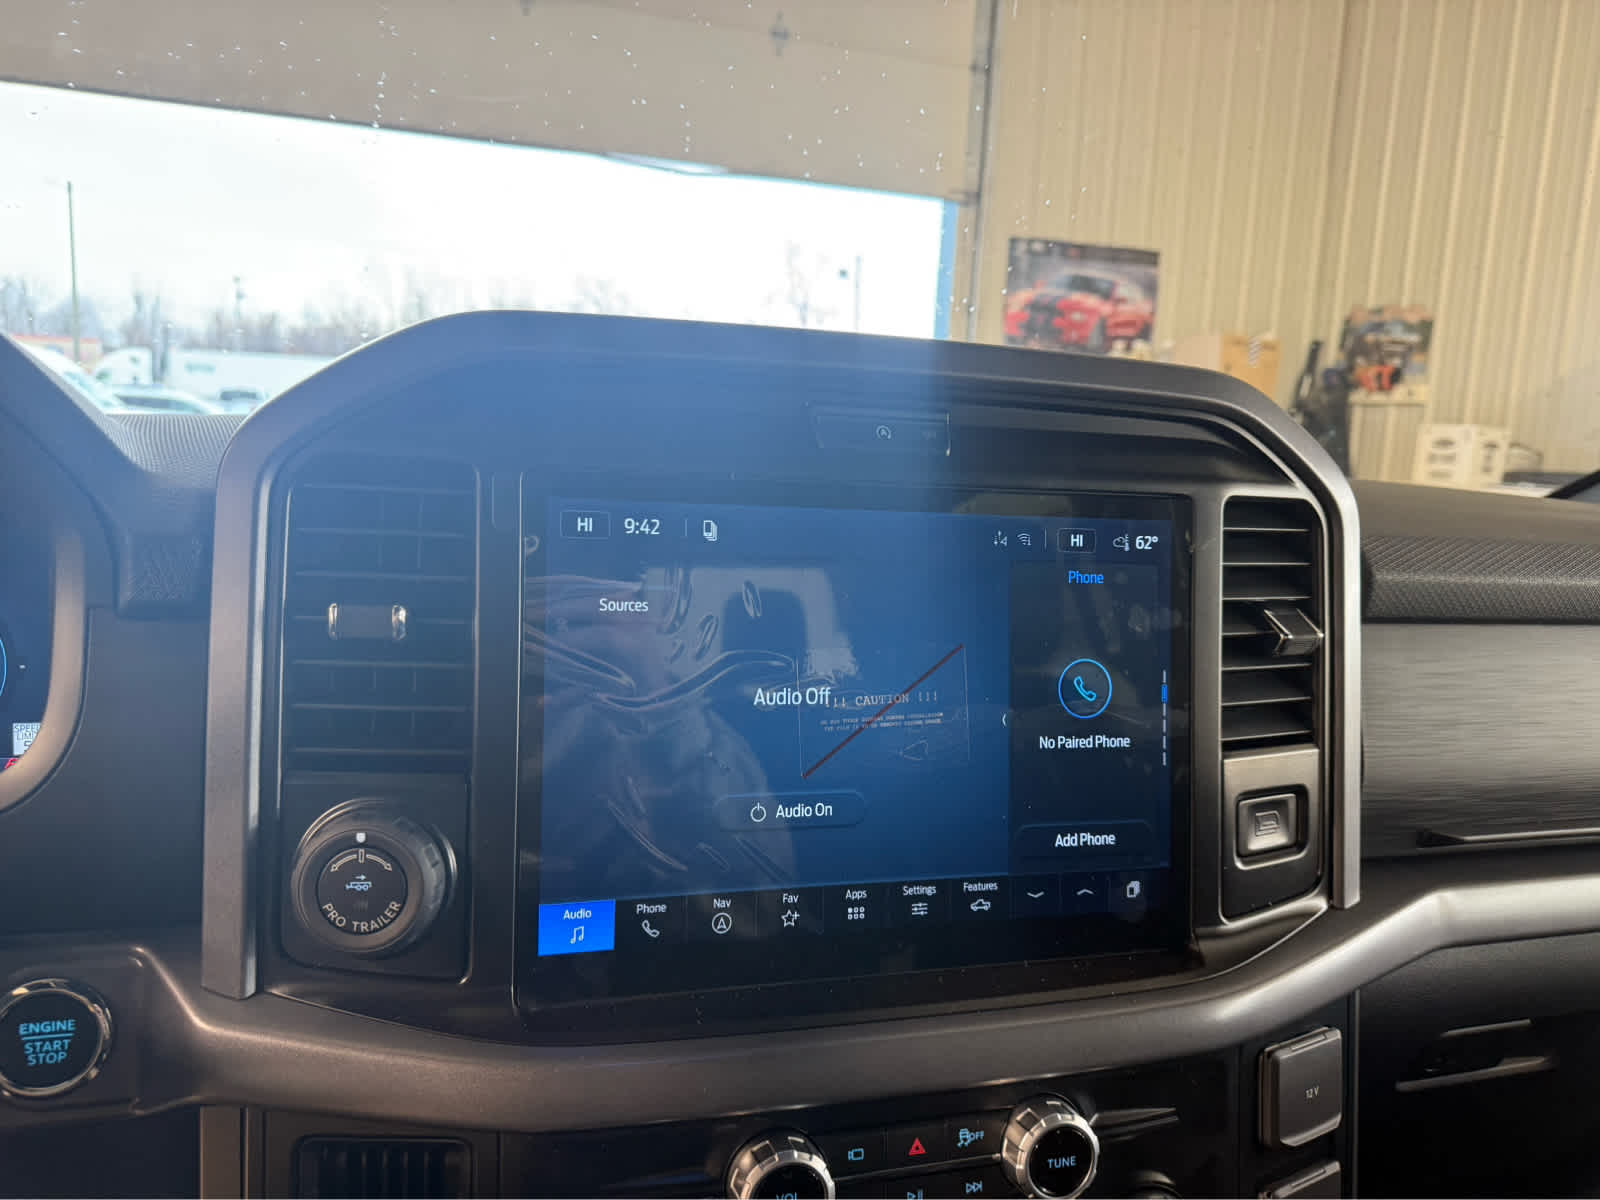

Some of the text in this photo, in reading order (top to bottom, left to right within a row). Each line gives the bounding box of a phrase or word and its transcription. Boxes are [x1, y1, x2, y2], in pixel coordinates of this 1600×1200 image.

[577, 516, 593, 533] HI
[624, 518, 661, 535] 9:42
[1070, 534, 1084, 548] HI
[1135, 535, 1159, 550] 62°
[1068, 570, 1105, 584] Phone
[599, 598, 649, 612] Sources
[753, 686, 831, 706] Audio Off
[855, 694, 909, 707] CAUTION
[1039, 735, 1131, 749] No Paired Phone
[775, 802, 833, 819] Audio On
[1055, 833, 1116, 847] Add Phone
[845, 889, 867, 900] Apps
[903, 885, 937, 896] Settings
[963, 882, 998, 893] Features
[713, 898, 732, 909] Nav
[782, 893, 799, 904] Fav
[563, 908, 592, 920] Audio
[636, 903, 667, 914] Phone
[322, 901, 402, 932] PRO TRAILER
[19, 1020, 76, 1035] ENGINE
[24, 1039, 71, 1054] START
[27, 1051, 67, 1066] STOP
[968, 1130, 985, 1141] OFF
[1048, 1156, 1077, 1168] TUNE
